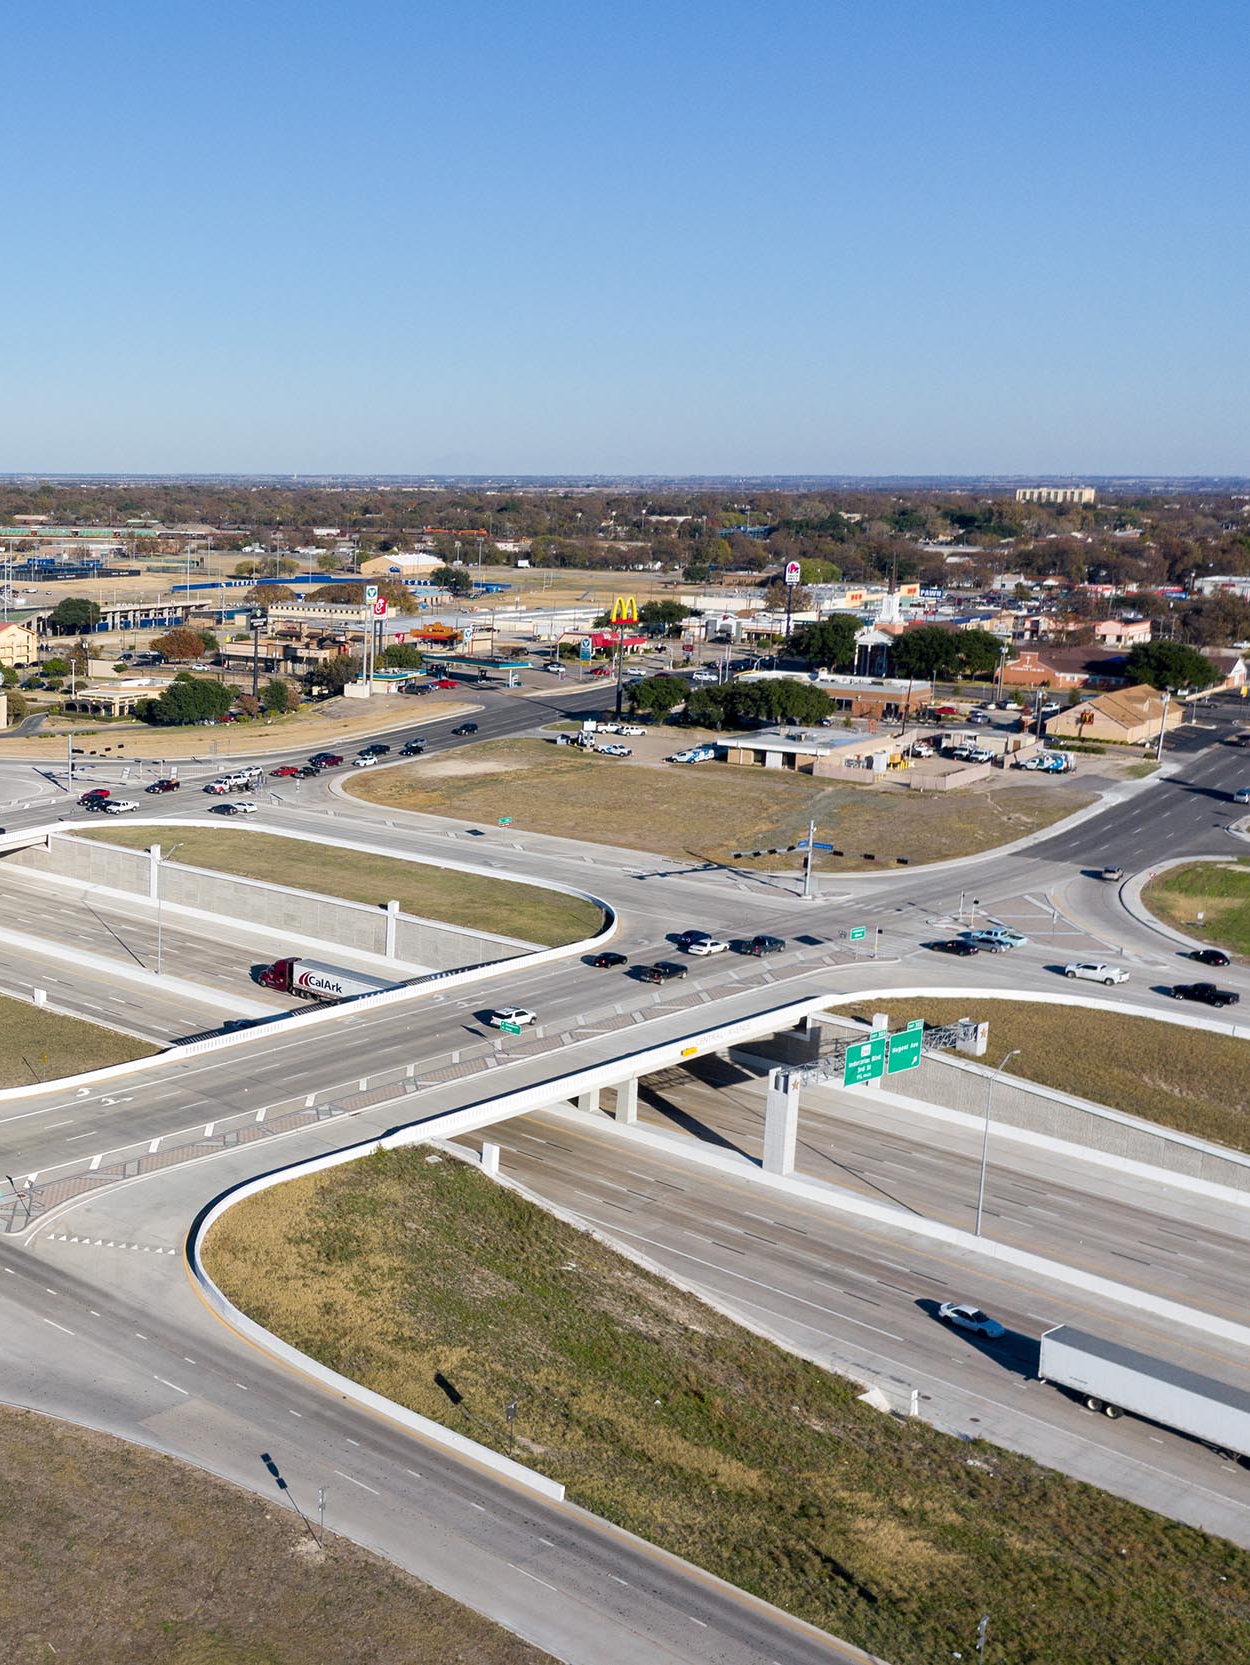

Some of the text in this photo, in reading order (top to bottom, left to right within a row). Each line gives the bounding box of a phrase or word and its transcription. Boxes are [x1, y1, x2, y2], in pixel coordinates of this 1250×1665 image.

[232, 579, 258, 587] TEMPLE
[920, 588, 942, 597] PAWN
[308, 975, 343, 994] CalArk
